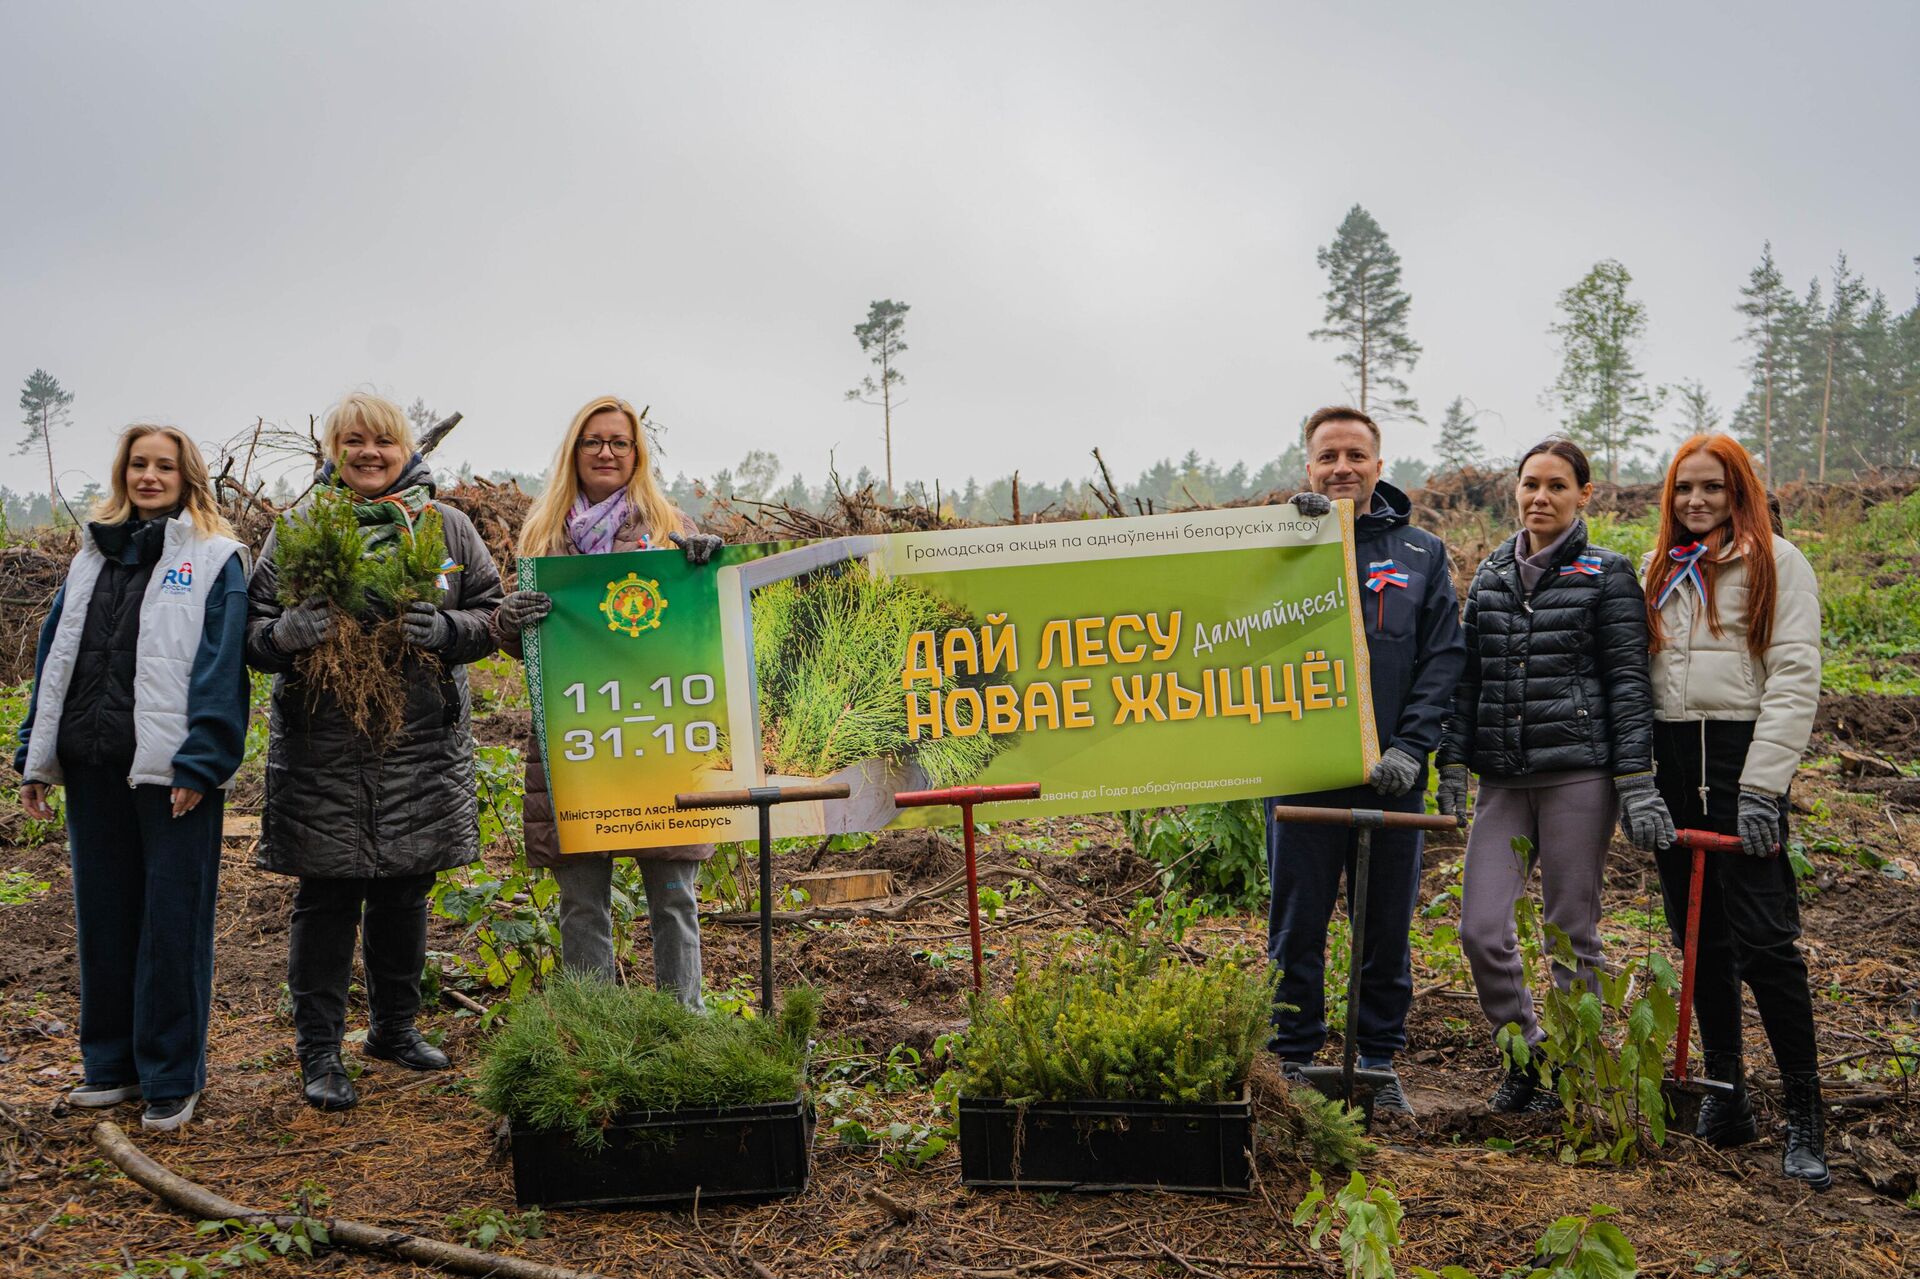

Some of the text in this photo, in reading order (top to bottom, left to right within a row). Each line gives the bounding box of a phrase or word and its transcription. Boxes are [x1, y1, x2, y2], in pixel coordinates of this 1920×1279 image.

[906, 517, 1321, 562] Грамадская акцыя па аднаўленні беларускіх лясоў
[1193, 576, 1345, 657] Далучайцеся!
[901, 611, 1182, 690] ДАЙ ЛЕСУ
[563, 673, 715, 713] 11.10
[905, 650, 1348, 740] НОВАЕ ЖЫЦЦЁ!
[564, 720, 718, 761] 31.10
[1081, 787, 1097, 799] да
[1100, 785, 1129, 797] Года
[1131, 776, 1262, 795] добраўпарадкавання
[559, 806, 642, 822] Міністэрства
[596, 816, 732, 834] Рэспублікі Беларусь
